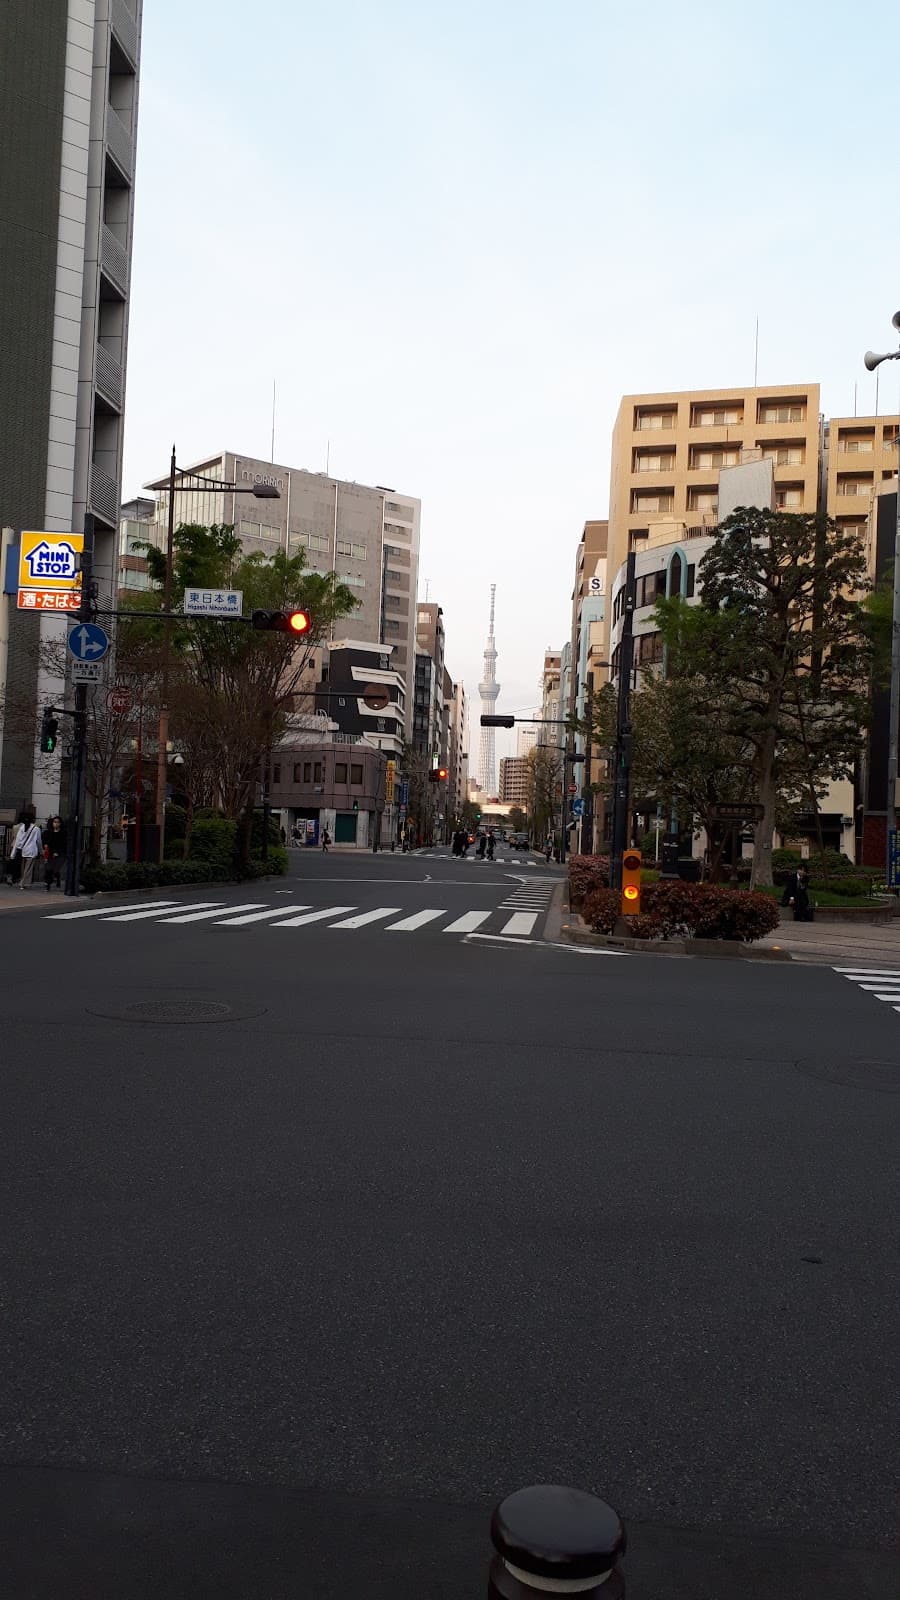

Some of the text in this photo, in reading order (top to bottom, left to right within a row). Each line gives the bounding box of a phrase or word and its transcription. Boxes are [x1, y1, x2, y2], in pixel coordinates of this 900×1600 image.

[39, 551, 70, 563] MINI
[36, 562, 71, 574] STOP
[592, 578, 600, 589] S
[189, 592, 237, 605] 東日本橋
[187, 603, 239, 612] Higashi Nihonbashi
